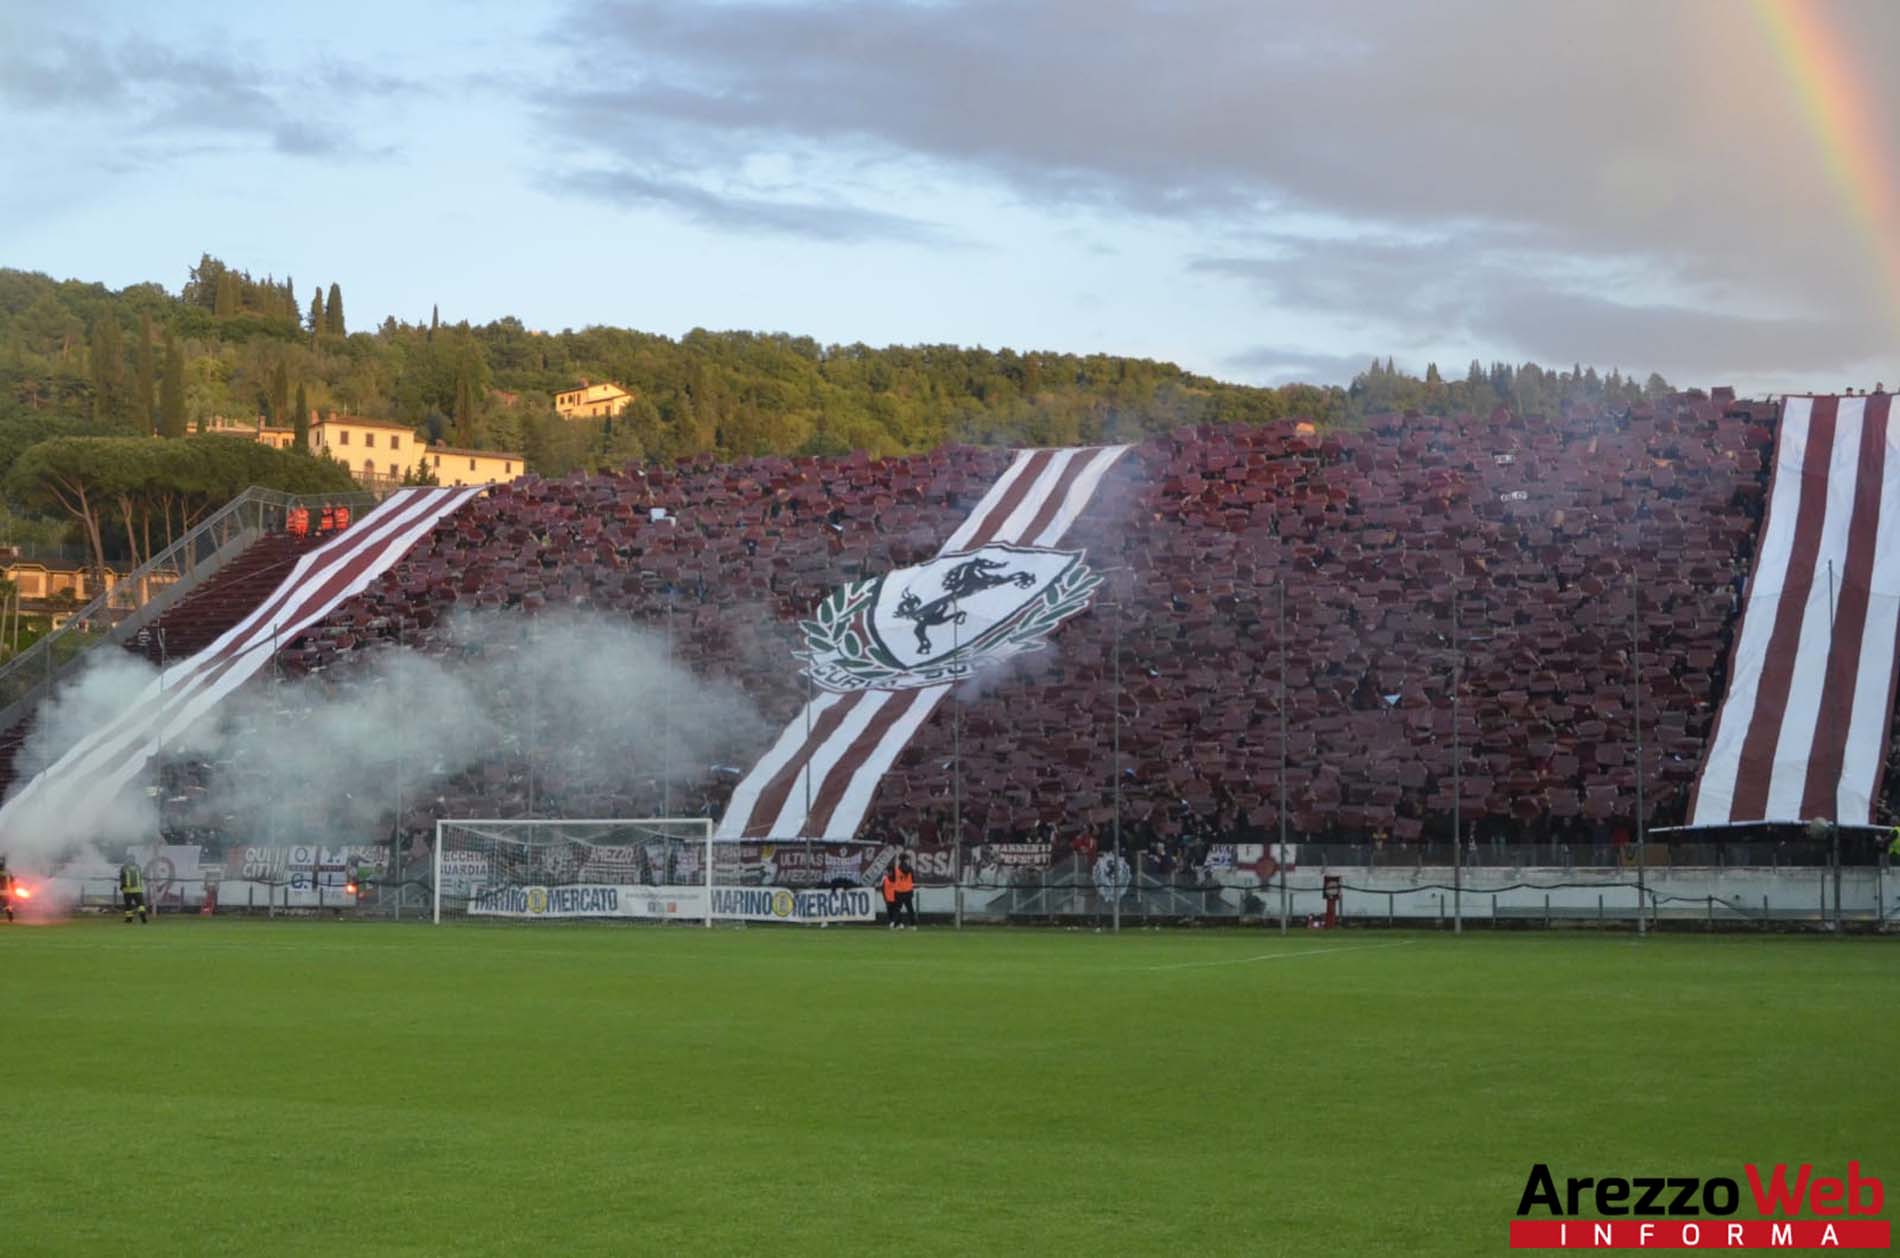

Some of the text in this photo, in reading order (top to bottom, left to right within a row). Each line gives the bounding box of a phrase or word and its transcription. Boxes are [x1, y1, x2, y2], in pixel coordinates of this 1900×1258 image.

[440, 863, 487, 876] UARDIA
[547, 887, 619, 914] MERCATO
[710, 889, 870, 918] MARINO MERCATO
